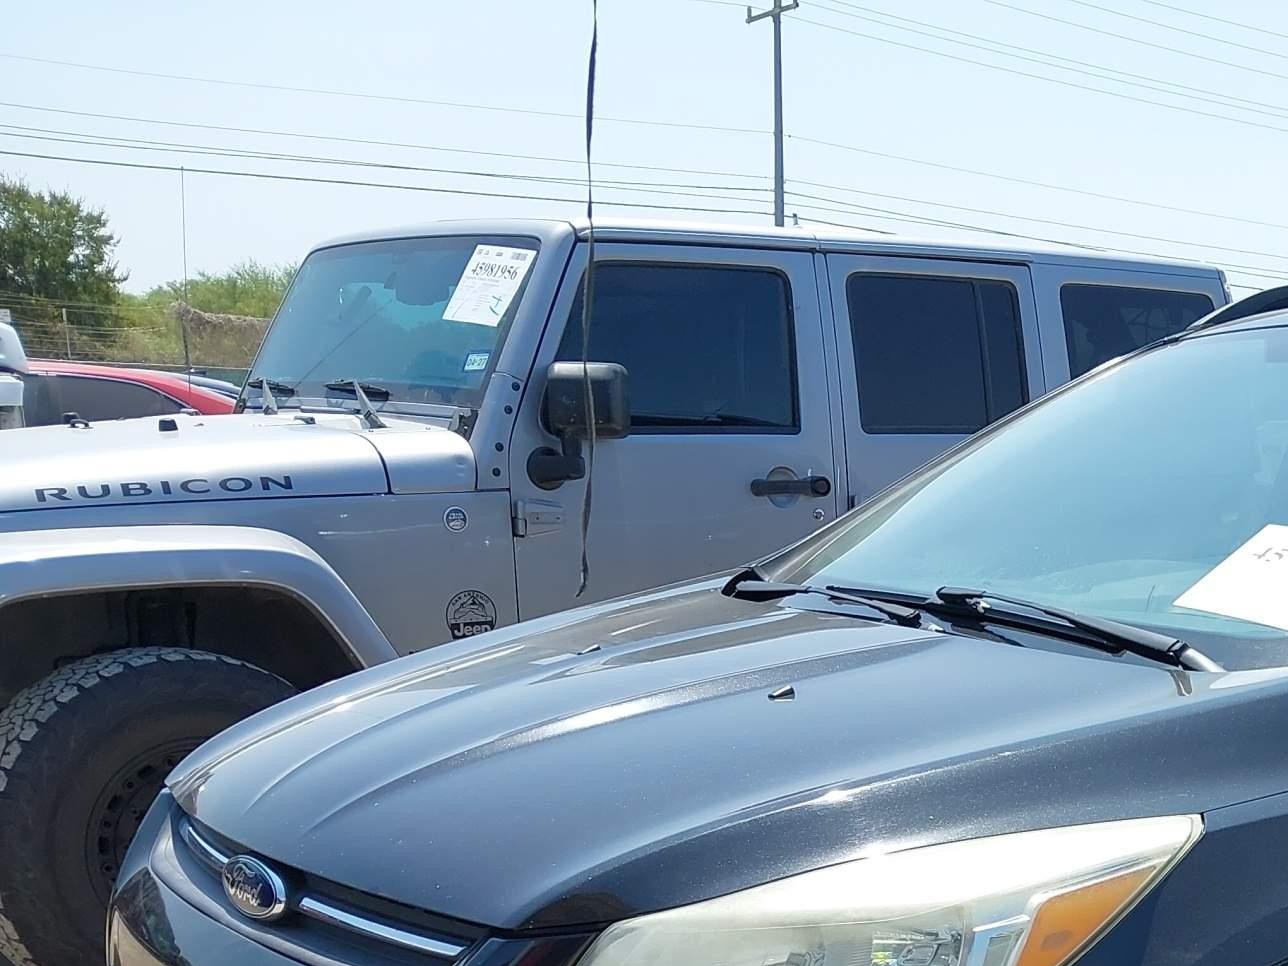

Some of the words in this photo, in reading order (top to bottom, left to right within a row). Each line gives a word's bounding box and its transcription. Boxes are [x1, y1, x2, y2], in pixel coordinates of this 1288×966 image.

[471, 261, 519, 280] 45981956
[34, 475, 294, 503] RUBICON
[225, 863, 263, 907] Ford
